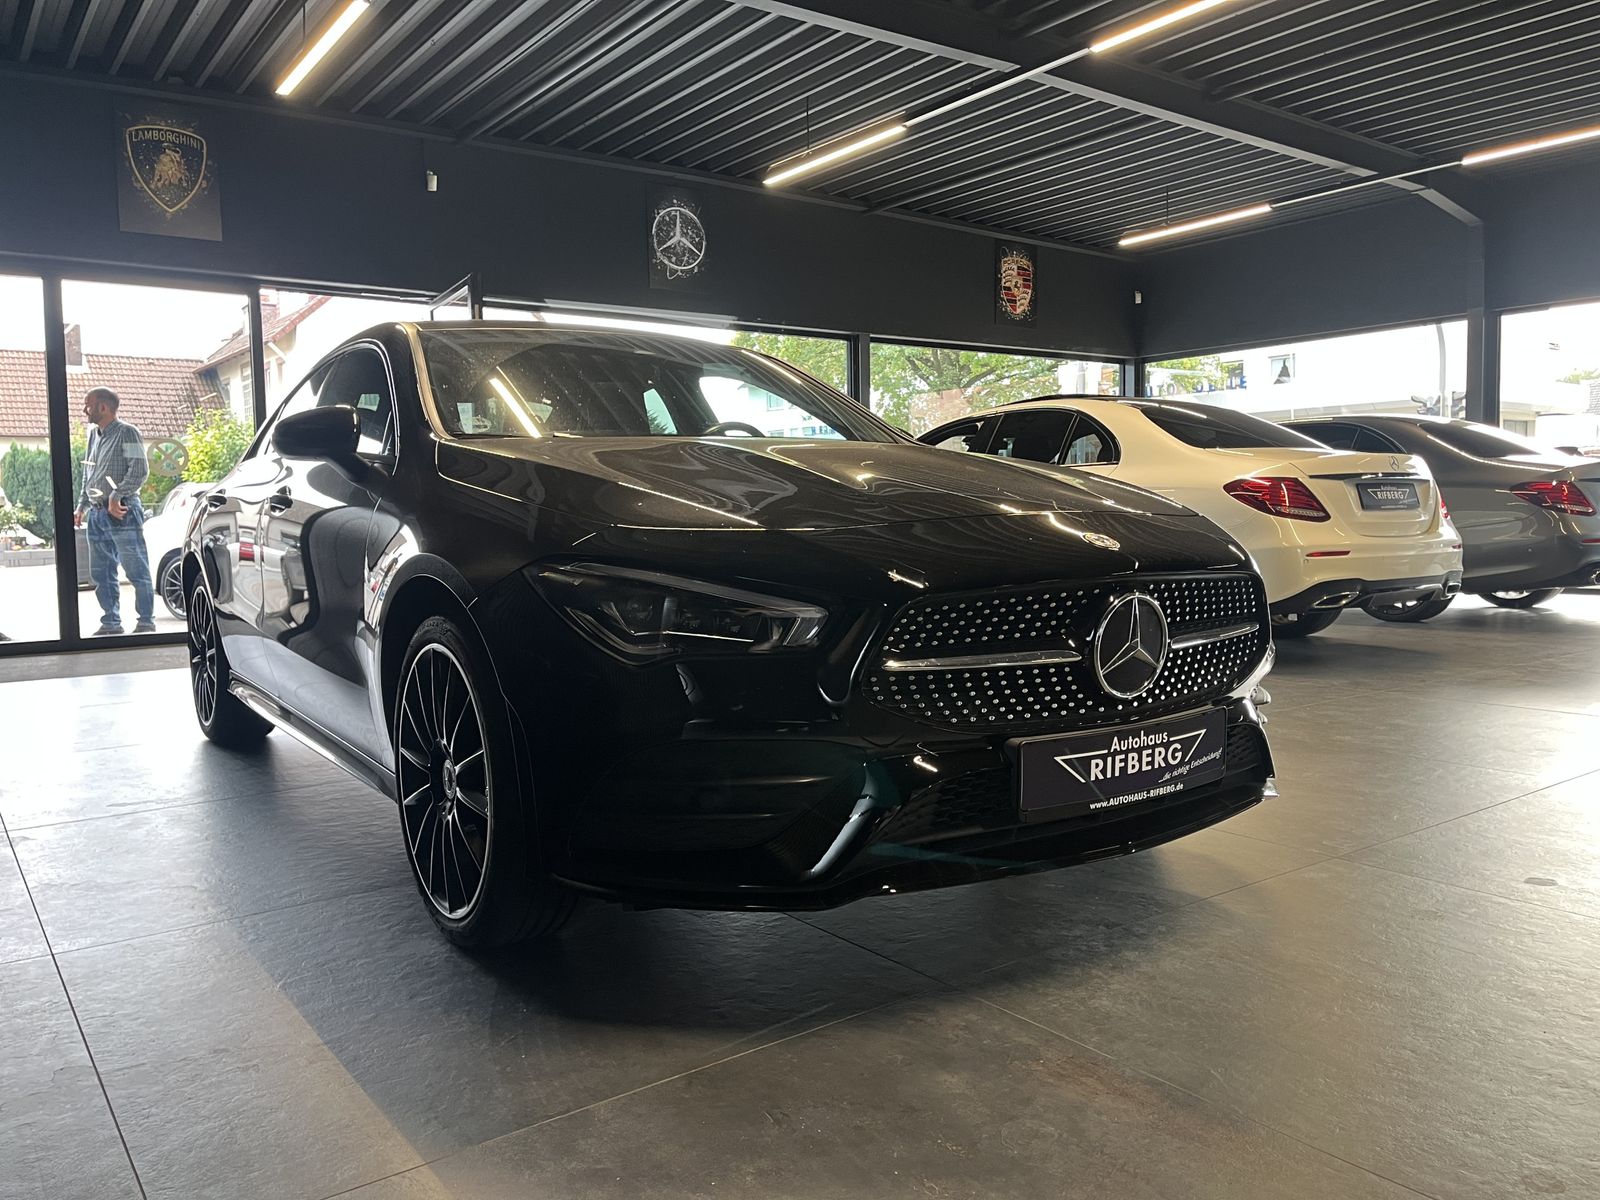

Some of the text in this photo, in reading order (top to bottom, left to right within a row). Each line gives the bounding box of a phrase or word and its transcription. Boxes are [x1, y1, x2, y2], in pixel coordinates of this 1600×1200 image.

[132, 130, 201, 150] LAMBORGHINI
[1376, 491, 1404, 500] RIFBERG
[1110, 730, 1168, 753] Autohaus
[1090, 743, 1183, 782] RIFBERG
[1172, 764, 1190, 775] richtige
[1089, 783, 1184, 809] www.AUTOHAUS-RIFBERG.de
